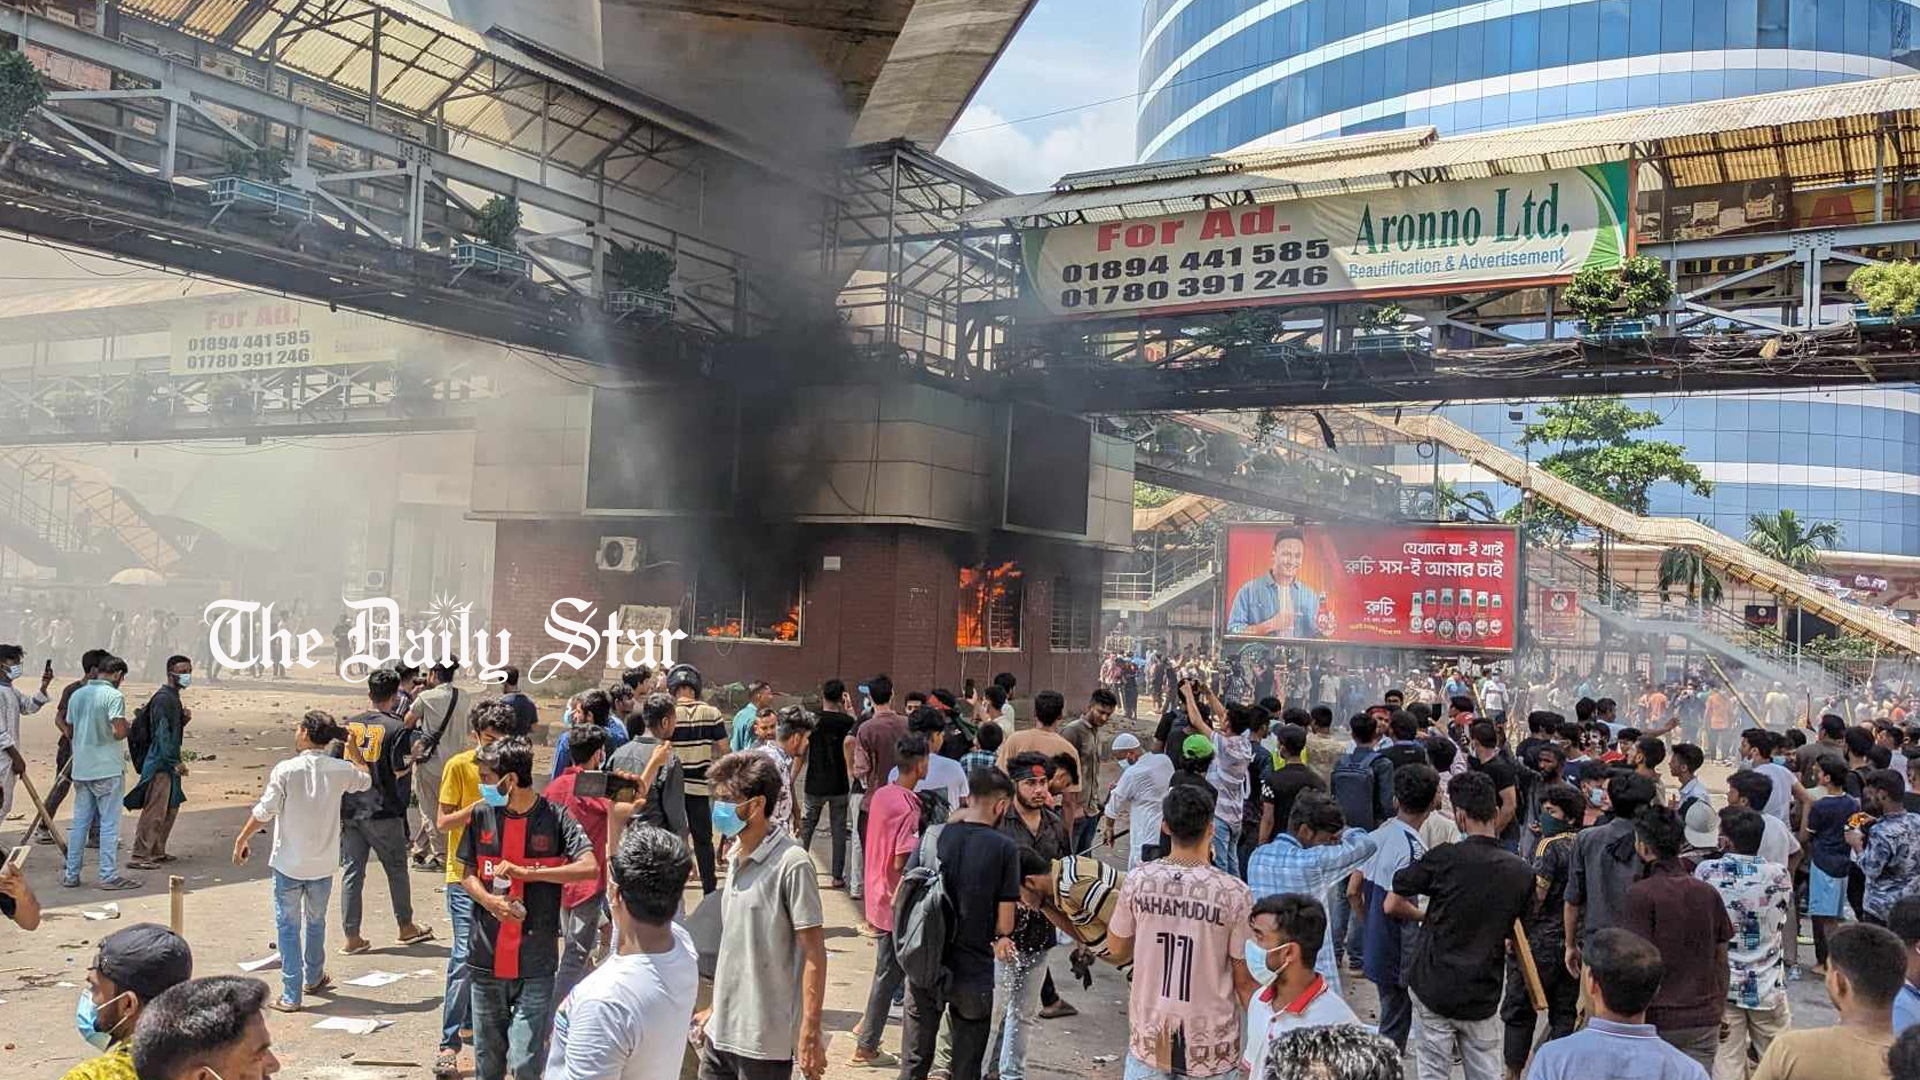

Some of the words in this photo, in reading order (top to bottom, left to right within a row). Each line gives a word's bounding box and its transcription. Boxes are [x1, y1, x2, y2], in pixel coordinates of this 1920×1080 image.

[1097, 218, 1185, 252] For
[1199, 204, 1291, 240] Ad.
[1350, 201, 1482, 256] Aronno
[1492, 182, 1571, 244] Ltd.
[1061, 254, 1170, 284] 01894
[1178, 246, 1243, 272] 441
[1252, 238, 1330, 265] 585
[1349, 258, 1442, 280] Beautification
[1445, 255, 1456, 273] &
[1458, 246, 1566, 271] Advertisement
[1060, 280, 1169, 308] 01780
[1177, 272, 1245, 298] 391
[1253, 264, 1329, 291] 246
[203, 308, 248, 331] For
[188, 334, 239, 352] 01894
[242, 331, 272, 349] 441
[275, 329, 311, 346] 585
[186, 350, 238, 370] 01780
[241, 350, 273, 367] 391
[276, 348, 311, 364] 246
[1402, 541, 1446, 556] যেখানে
[1481, 540, 1504, 557] খাই
[1344, 555, 1376, 575] রুচি
[1378, 557, 1422, 577] সস-ই
[1425, 560, 1474, 578] আমার
[1477, 559, 1504, 578] চাই
[1363, 596, 1396, 617] রুচি
[1133, 895, 1225, 927] MAHAMUDUL
[1155, 931, 1194, 1003] 11
